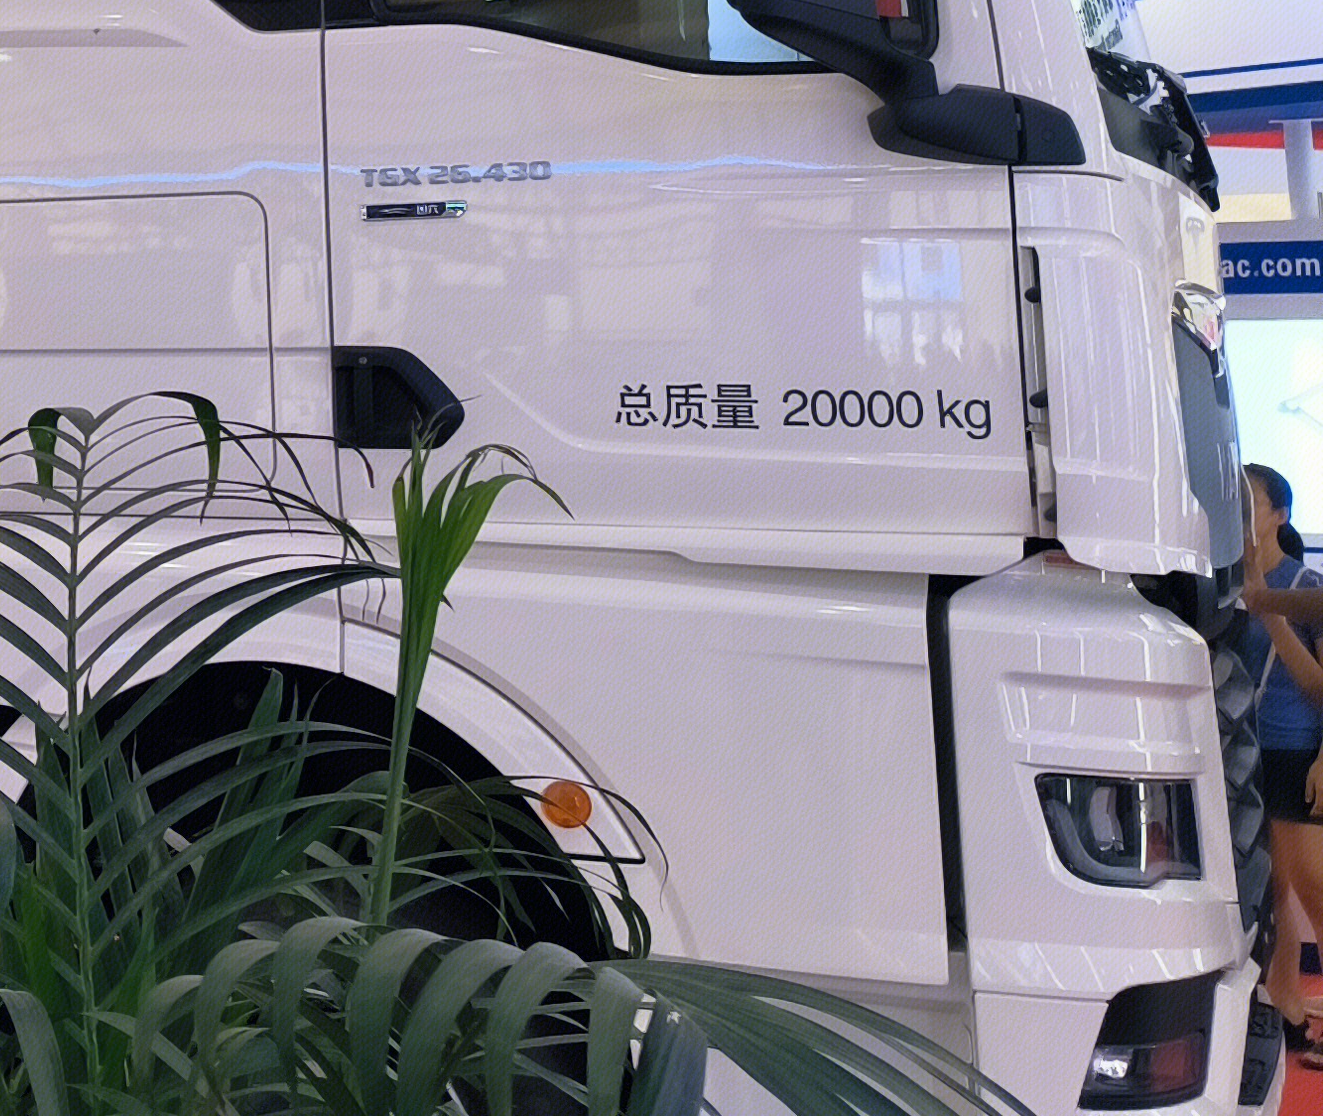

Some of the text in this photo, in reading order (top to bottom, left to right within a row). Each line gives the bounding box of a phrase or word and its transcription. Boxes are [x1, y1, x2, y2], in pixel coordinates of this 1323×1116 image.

[360, 160, 553, 187] TGX 26.430
[614, 383, 992, 440] 总质量 20000 kg
